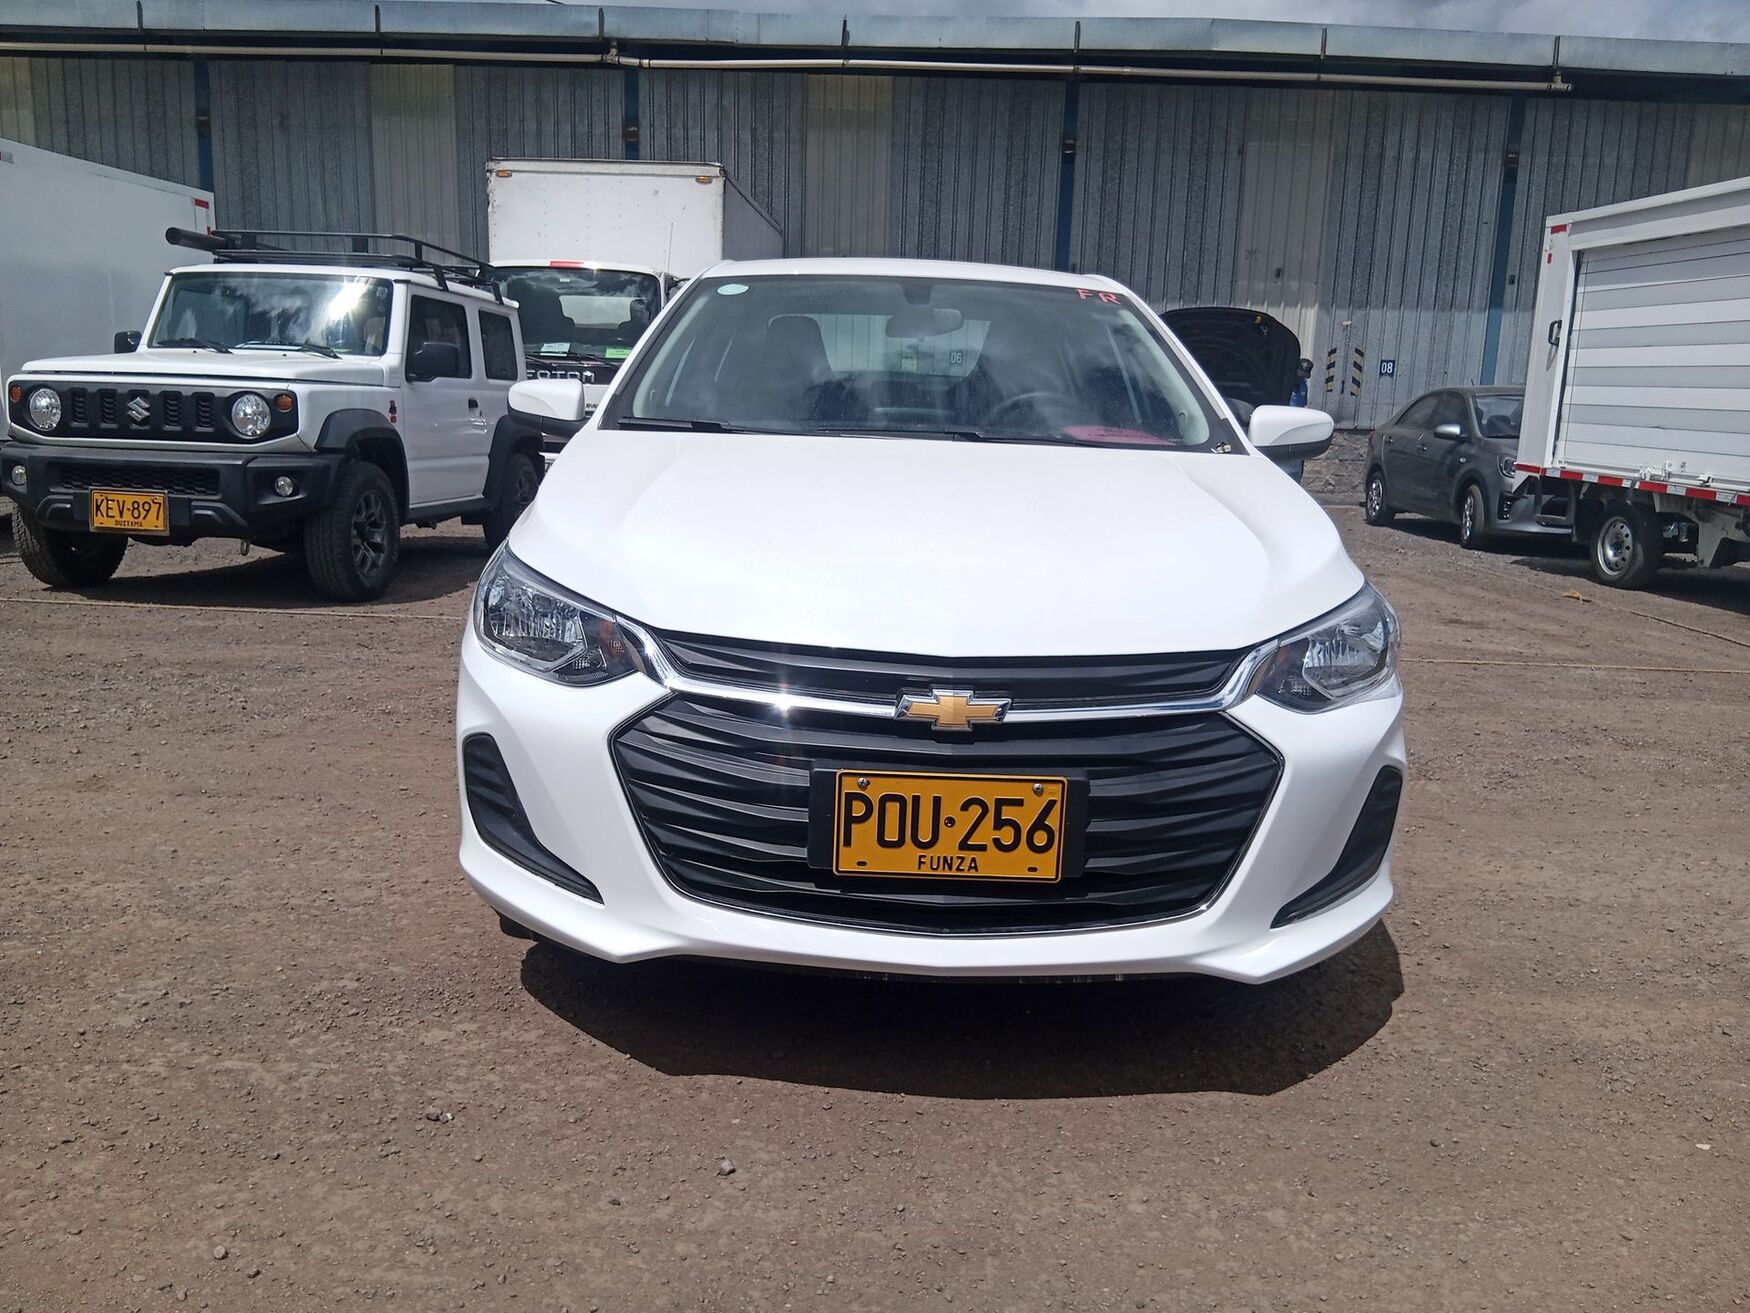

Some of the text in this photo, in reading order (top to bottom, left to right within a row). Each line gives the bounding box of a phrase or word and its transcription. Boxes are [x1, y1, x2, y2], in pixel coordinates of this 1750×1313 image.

[951, 352, 962, 364] 06
[1381, 362, 1393, 373] 08
[917, 854, 979, 873] FUNZA
